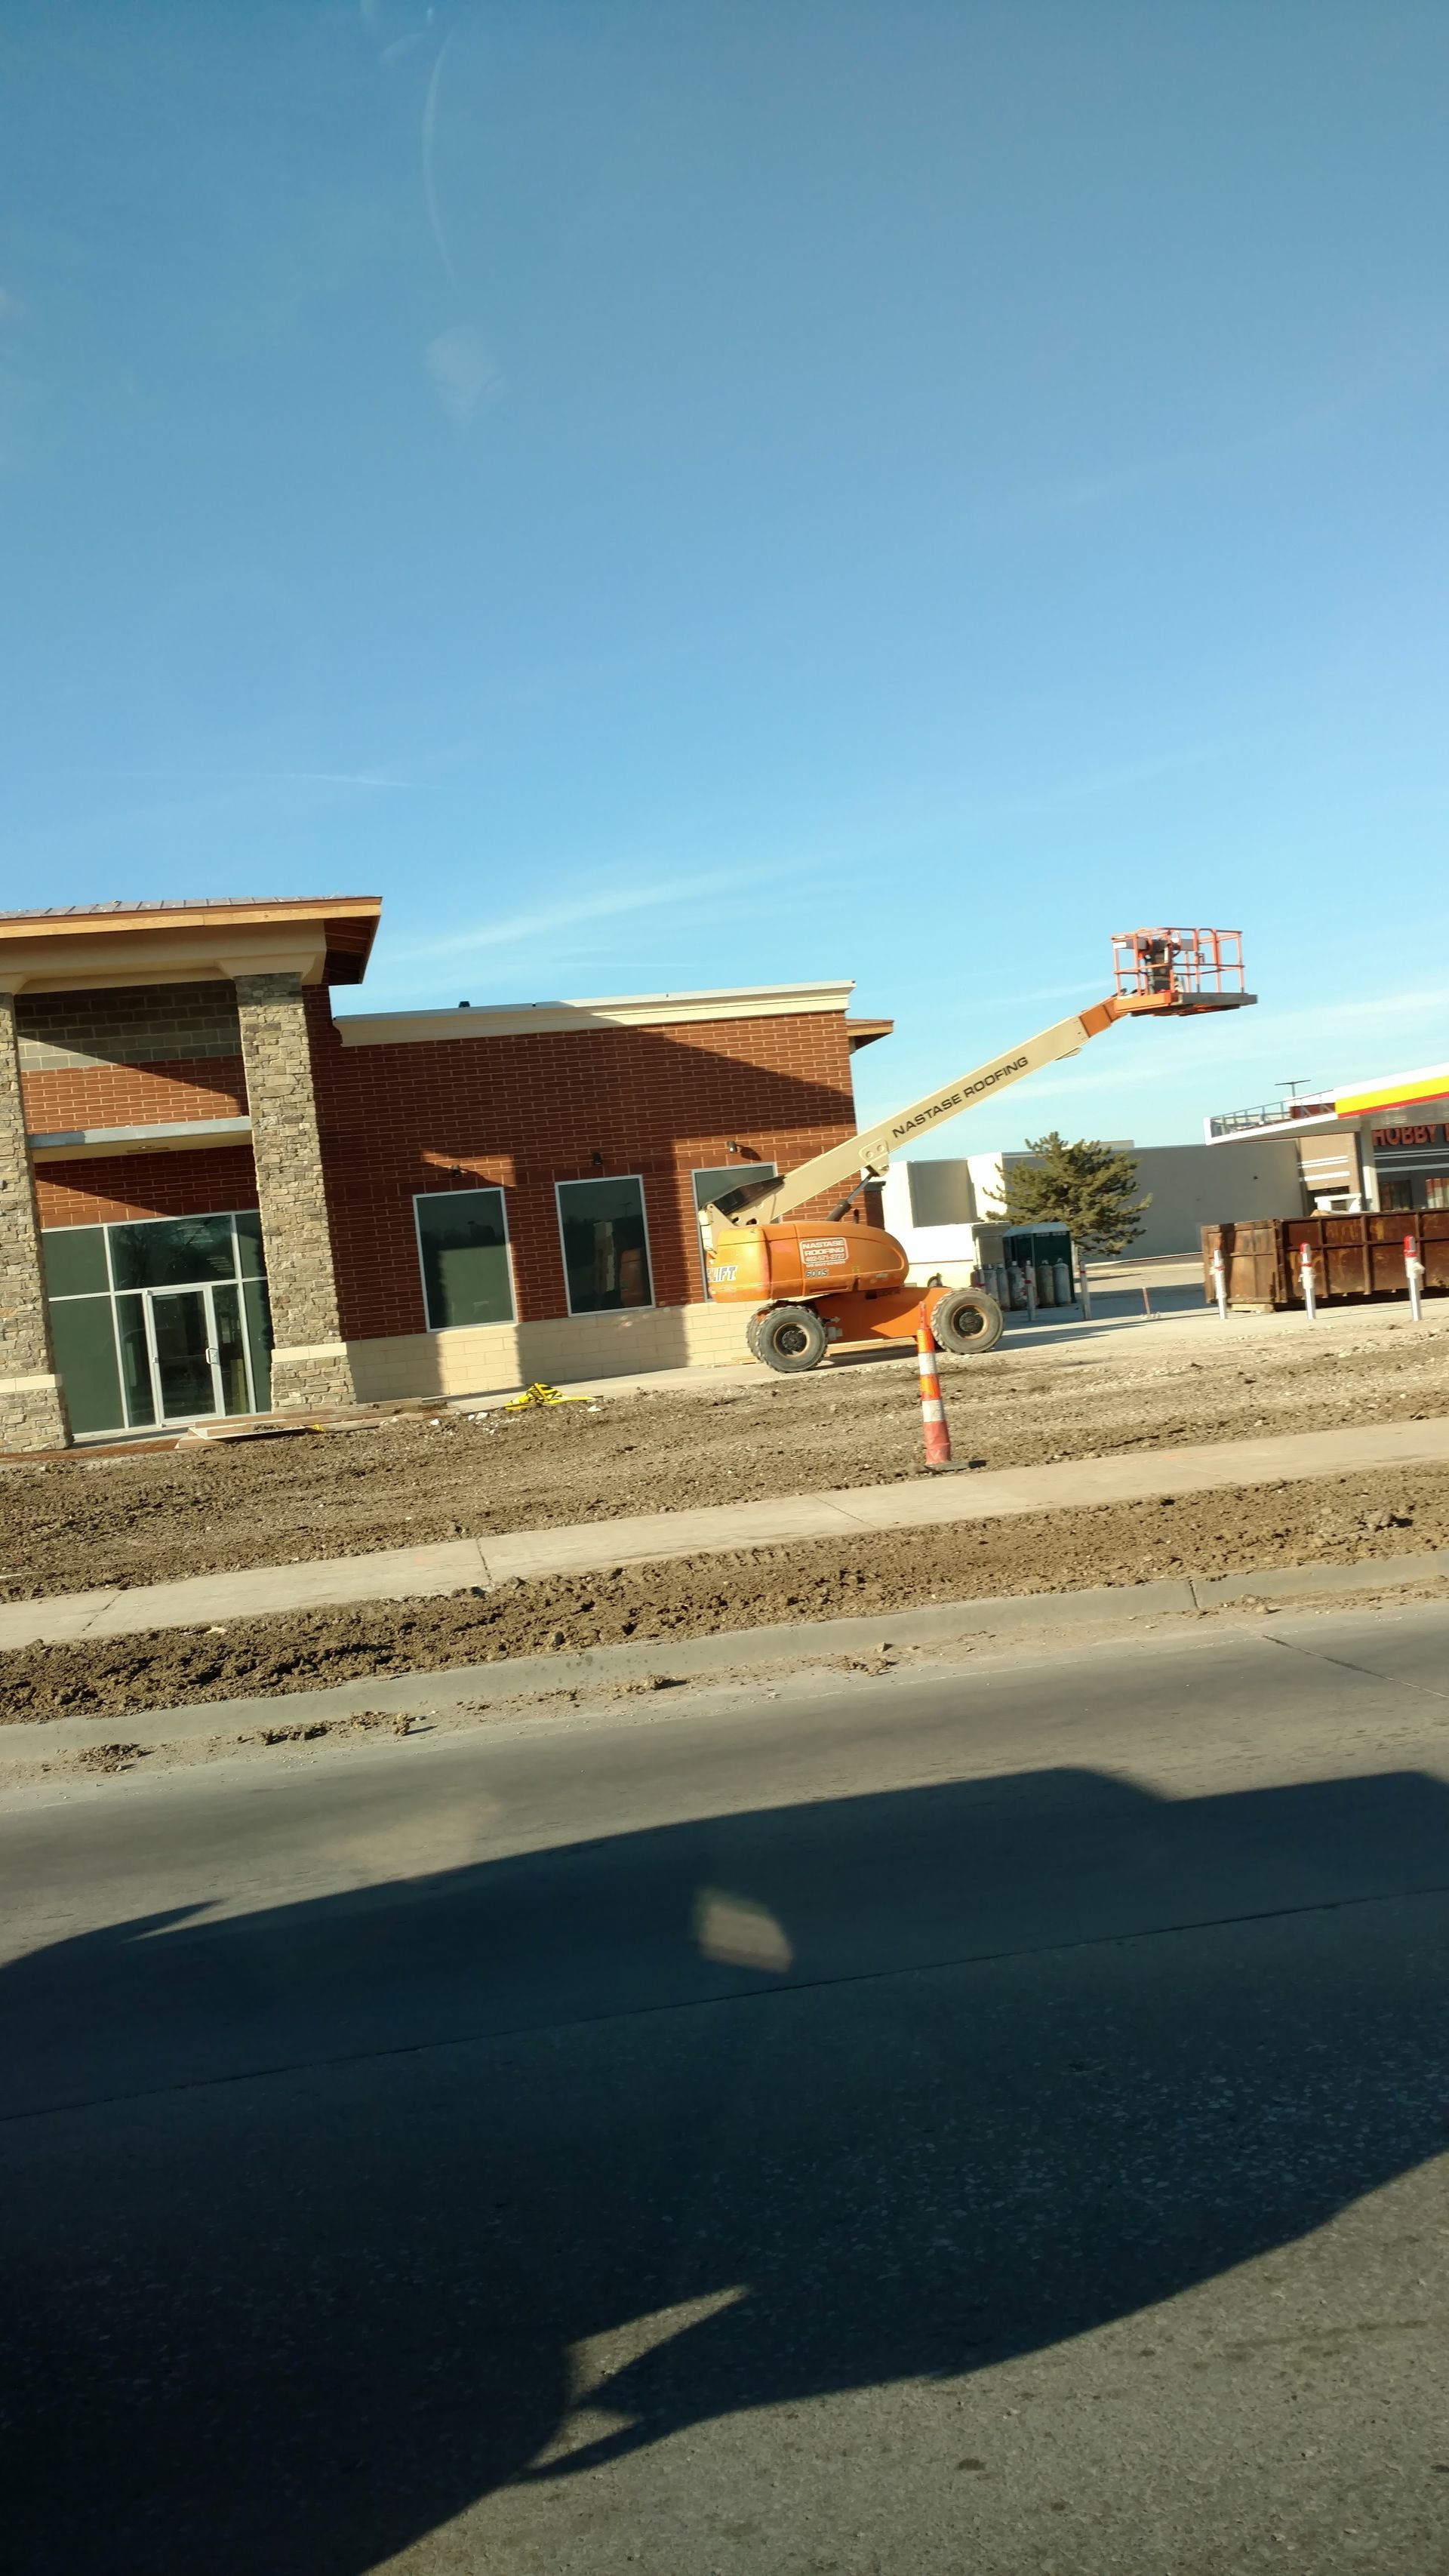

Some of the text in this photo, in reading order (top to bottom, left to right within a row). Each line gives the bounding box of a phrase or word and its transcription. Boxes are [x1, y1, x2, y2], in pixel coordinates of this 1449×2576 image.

[892, 1057, 1029, 1138] NASTASE ROOFING
[1372, 1124, 1437, 1146] HOBBY
[802, 1240, 844, 1249] NASTASE
[804, 1248, 844, 1256] ROOFING
[805, 1269, 828, 1278] 600S
